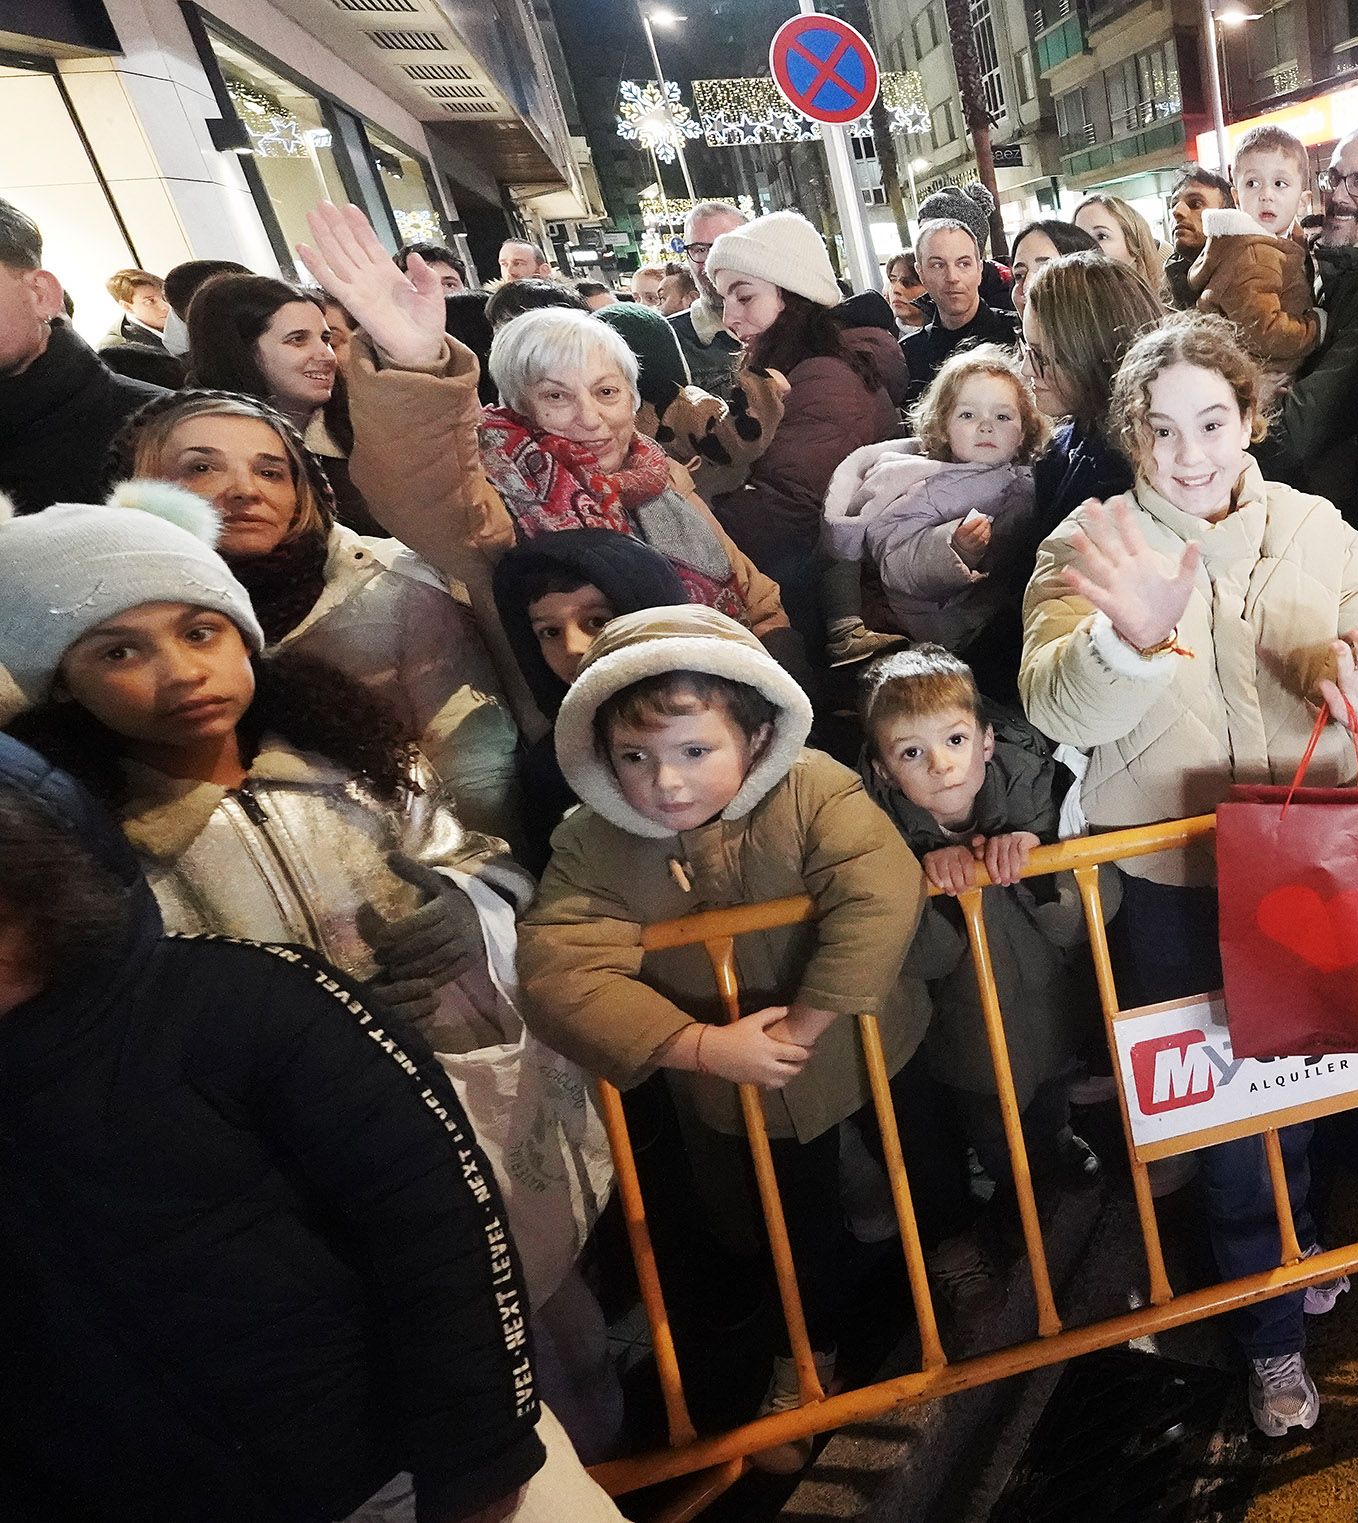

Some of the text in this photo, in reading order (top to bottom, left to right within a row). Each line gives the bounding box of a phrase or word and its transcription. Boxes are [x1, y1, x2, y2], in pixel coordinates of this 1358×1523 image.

[992, 149, 1022, 160] aez
[315, 969, 373, 1025] LEVEL
[368, 1028, 417, 1076] NEXT
[1249, 1059, 1350, 1093] ALQUILER
[458, 1149, 491, 1204] NEXT
[485, 1216, 512, 1286] LEVEL
[495, 1290, 526, 1350] NEXT
